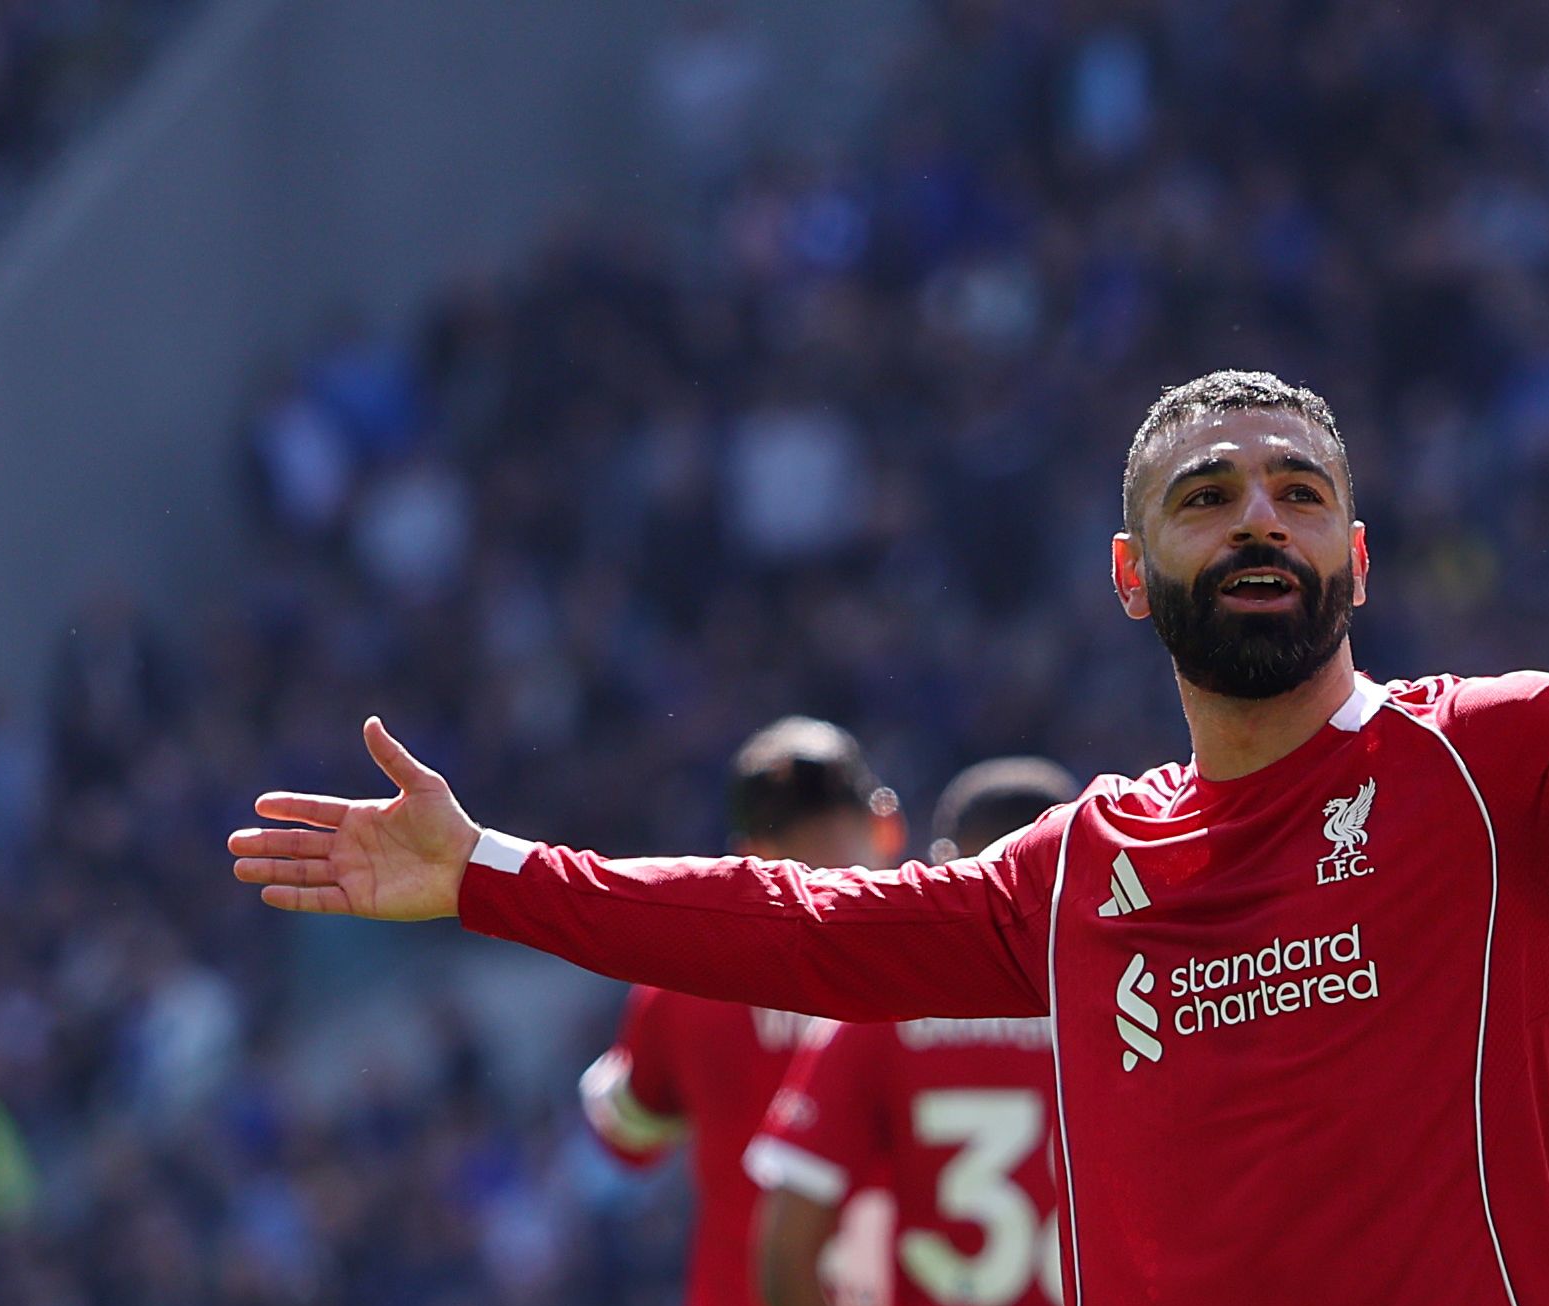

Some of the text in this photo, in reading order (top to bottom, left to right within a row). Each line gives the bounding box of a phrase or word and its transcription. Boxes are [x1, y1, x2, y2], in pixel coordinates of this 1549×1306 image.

[1315, 855, 1375, 885] L.F.C.
[1170, 923, 1362, 998] standard
[1174, 959, 1380, 1036] chartered
